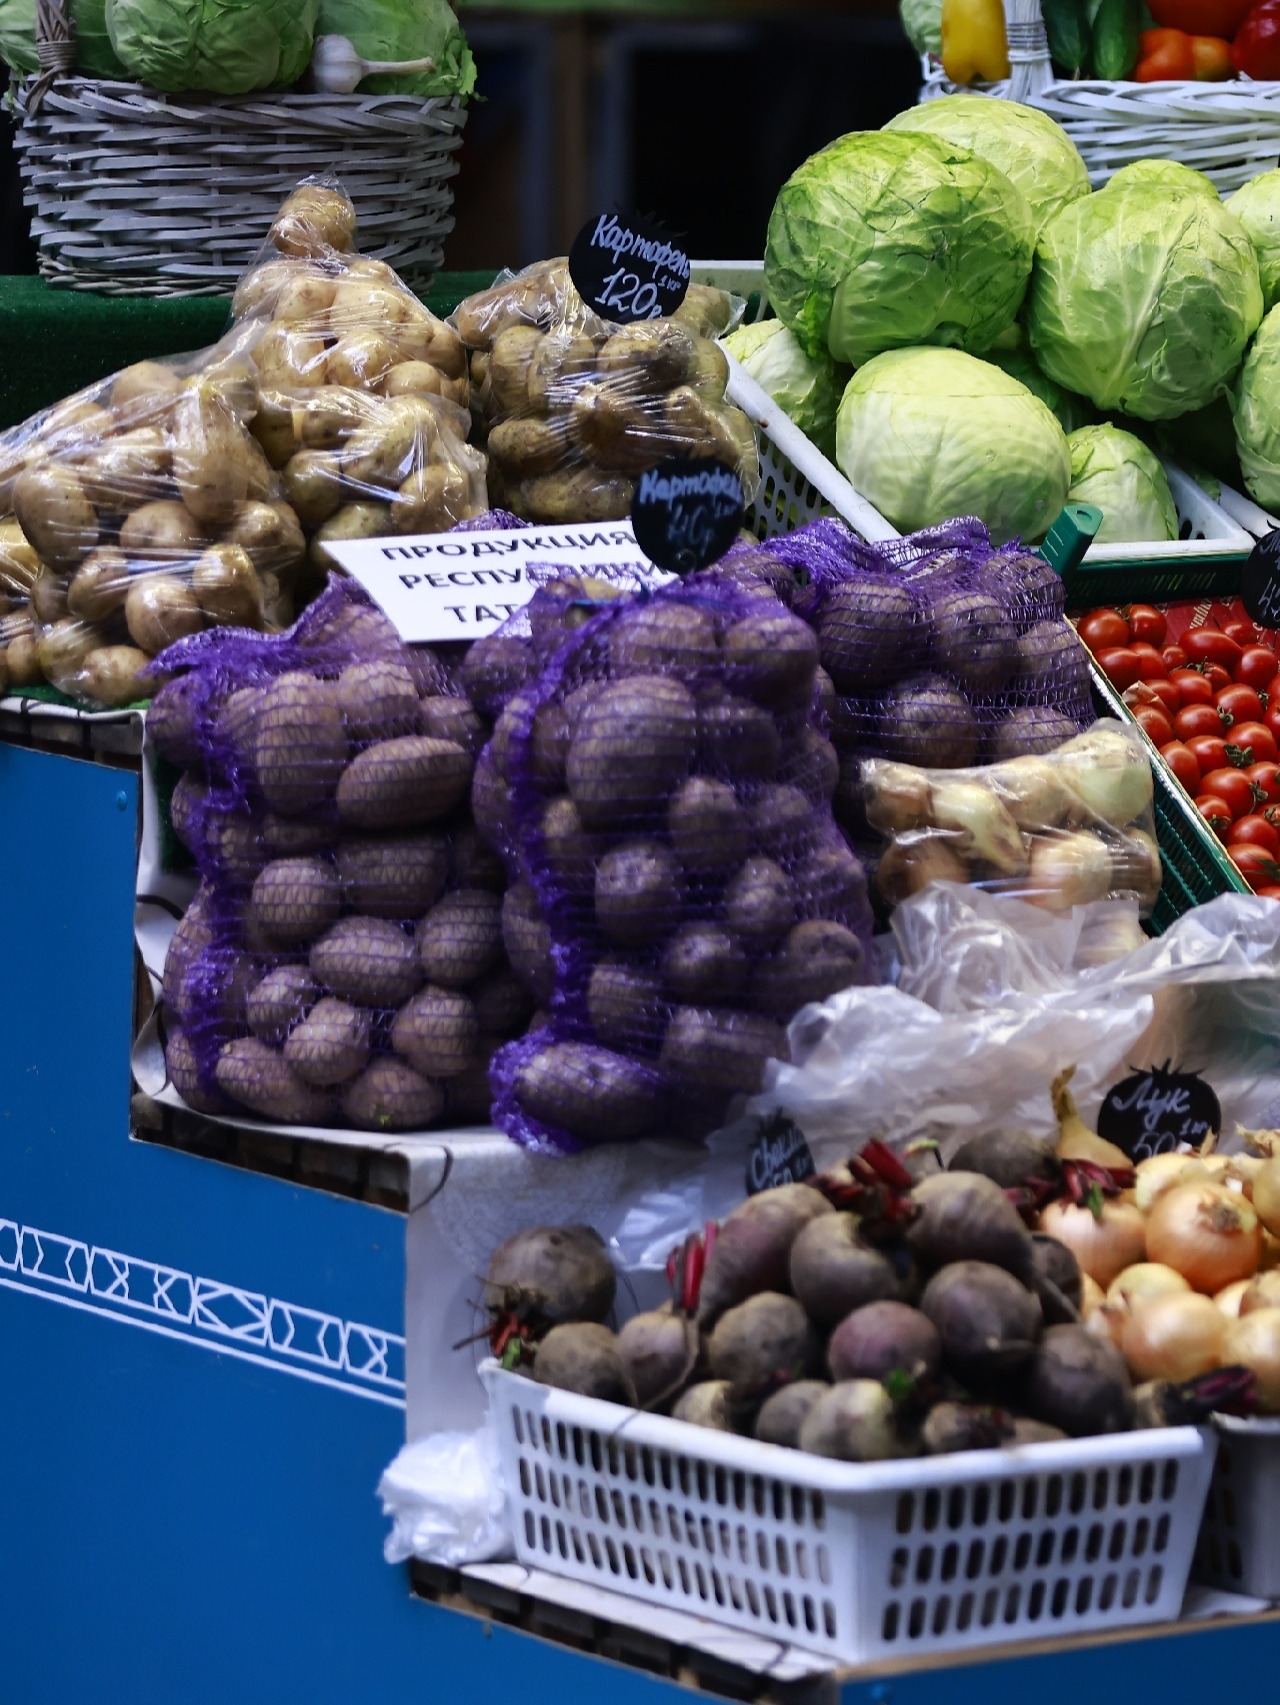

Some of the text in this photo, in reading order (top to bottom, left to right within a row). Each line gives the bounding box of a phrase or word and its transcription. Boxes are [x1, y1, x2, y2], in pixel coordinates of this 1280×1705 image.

[589, 213, 691, 280] Картофель
[380, 530, 638, 561] ПРОДУКЦИЯ
[1111, 1076, 1191, 1132] Лук
